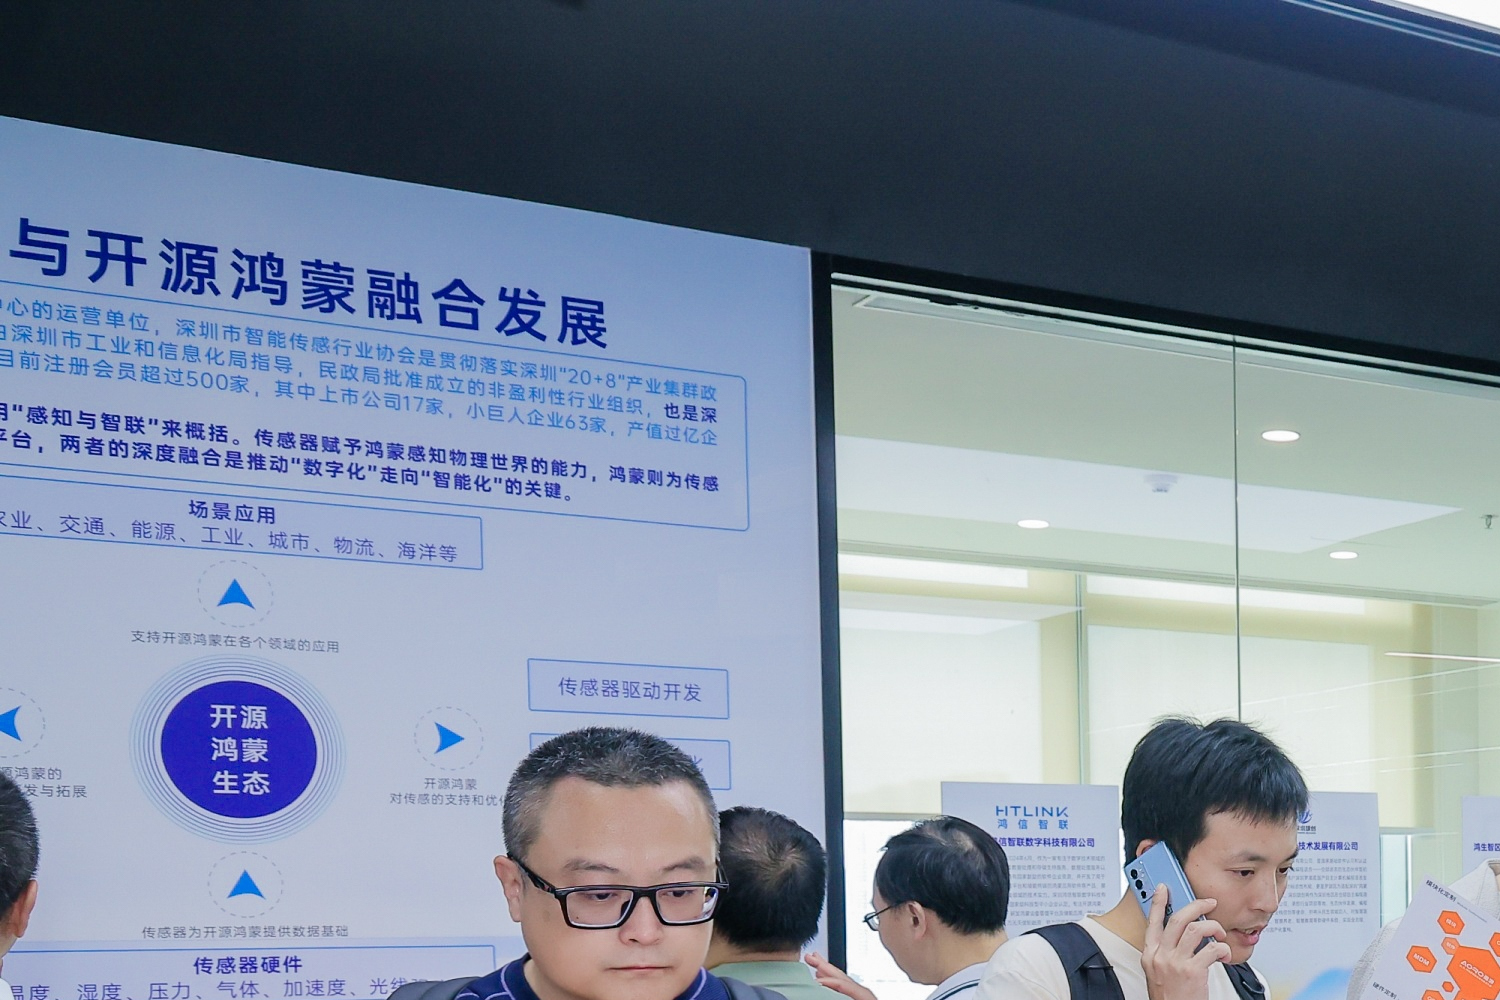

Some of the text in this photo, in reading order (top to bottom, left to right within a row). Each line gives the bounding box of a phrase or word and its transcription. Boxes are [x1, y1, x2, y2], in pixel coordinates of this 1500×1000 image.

[9, 217, 608, 349] 与开源鸿蒙融合发展
[0, 297, 718, 402] 心的运营单位，深圳市智能传感行业协会是贯彻落实深圳“20+8”产业集群政
[188, 499, 276, 525] 场景应用
[0, 509, 458, 563] 业、交通、能源、工业、城市、物流、海洋等
[131, 629, 340, 654] 支持开源鸿蒙在各个领域的应用
[558, 676, 702, 702] 传感器驱动开发
[209, 703, 269, 730] 开源
[210, 736, 269, 763] 鸿蒙
[18, 783, 88, 798] 发与拓展
[212, 769, 271, 796] 生态
[424, 777, 477, 791] 开源鸿蒙
[995, 805, 1069, 818] HTLINK
[997, 819, 1069, 830] 鸿信智联
[141, 924, 349, 939] 传感器为开源鸿蒙提供数据基础
[193, 955, 303, 975] 传感器硬件
